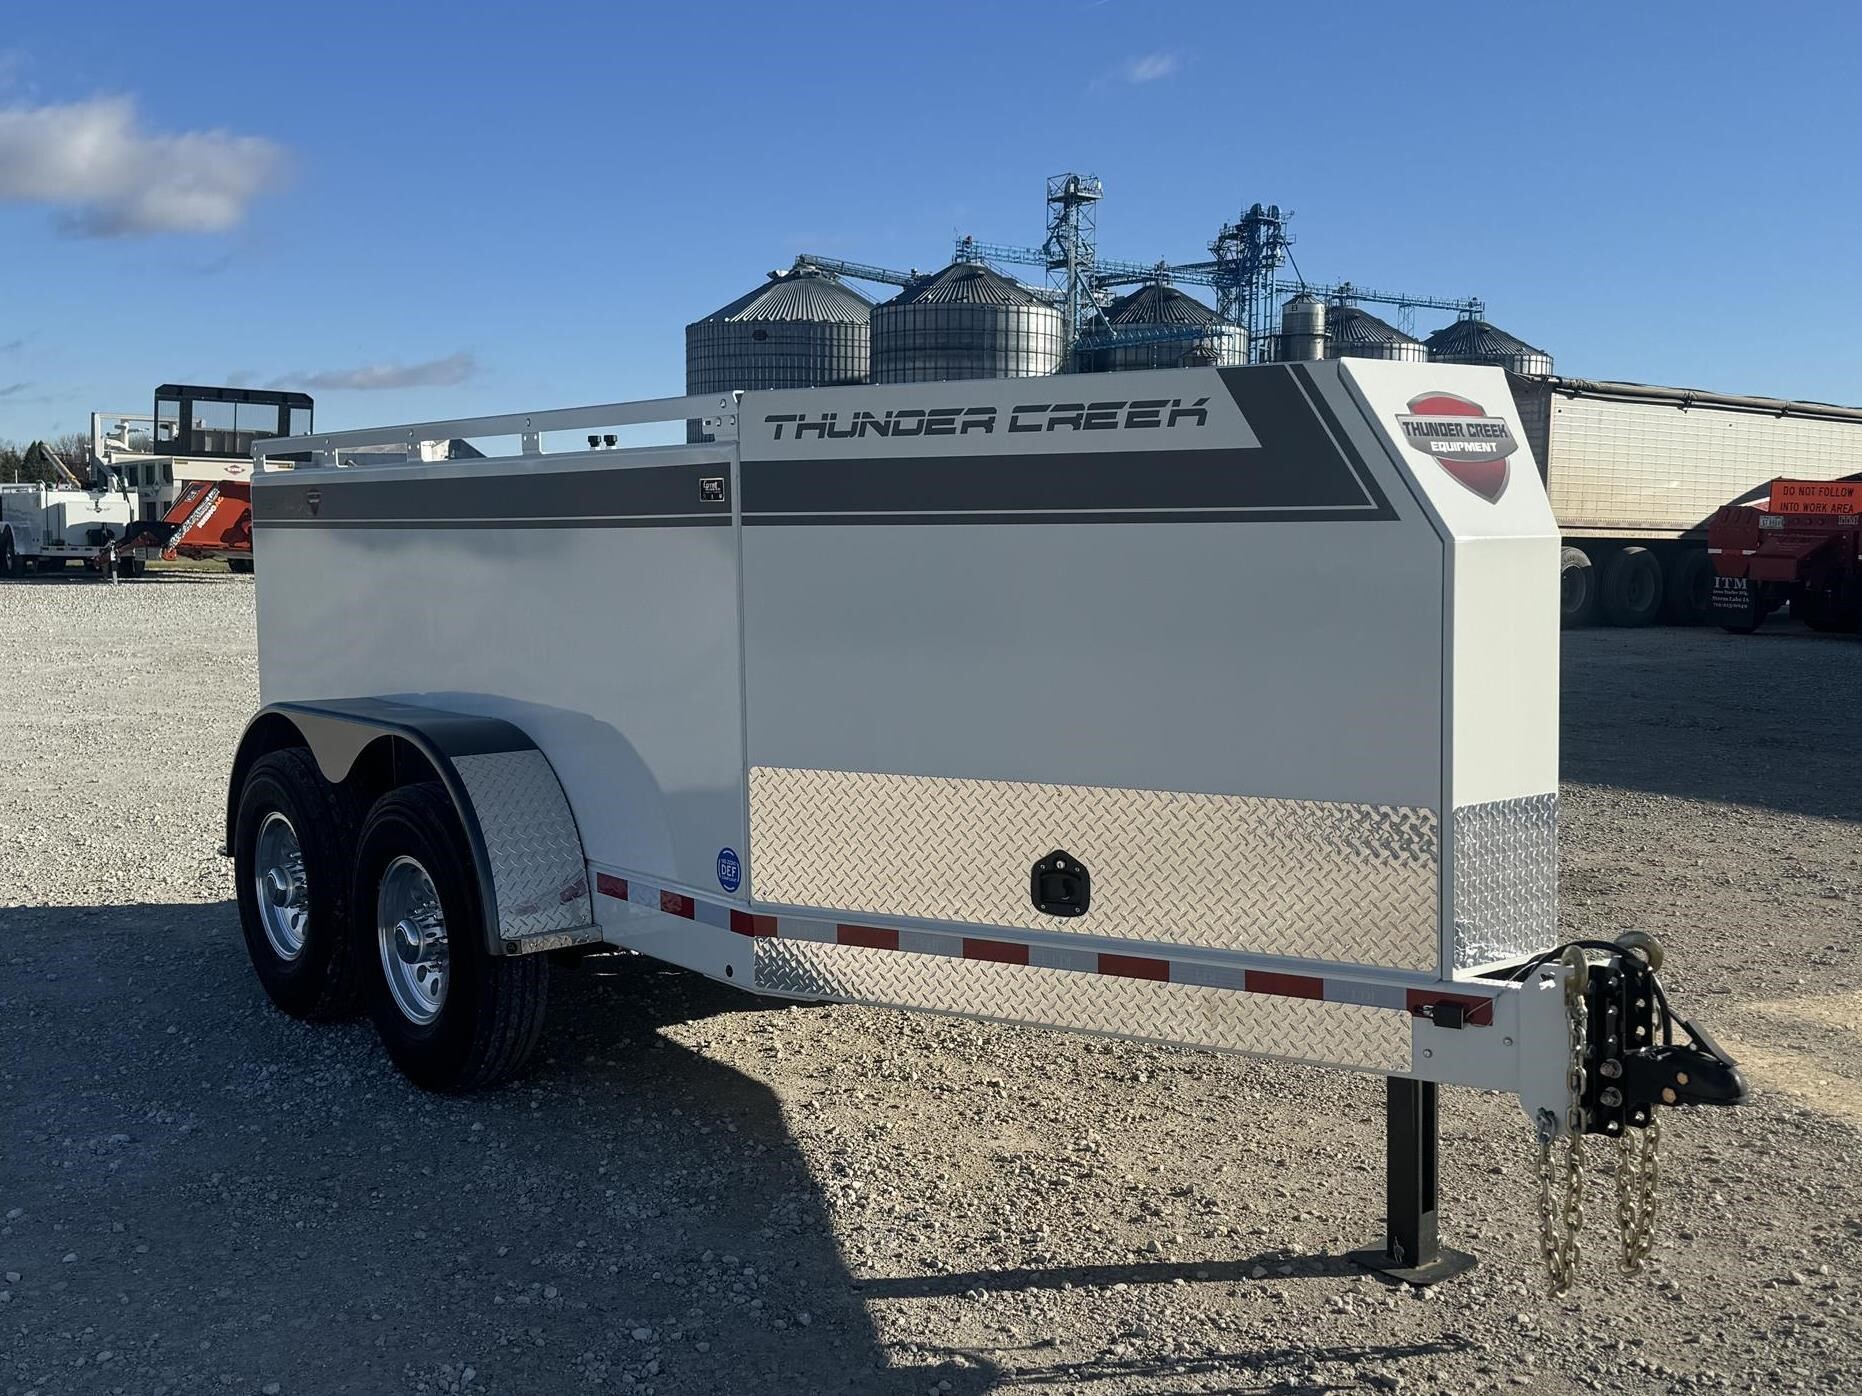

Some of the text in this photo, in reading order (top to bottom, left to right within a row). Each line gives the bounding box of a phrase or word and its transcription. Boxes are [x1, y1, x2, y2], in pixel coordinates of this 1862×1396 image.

[764, 396, 1211, 440] THUNDER CREEK
[1402, 421, 1508, 439] THUNDER CREEK
[1430, 440, 1497, 453] EQUIPMENT
[1783, 486, 1855, 497] DO NOT FOLLOW
[1780, 502, 1854, 513] INTO WORK AREA
[1714, 576, 1747, 589] ITM
[721, 863, 737, 877] DEF
